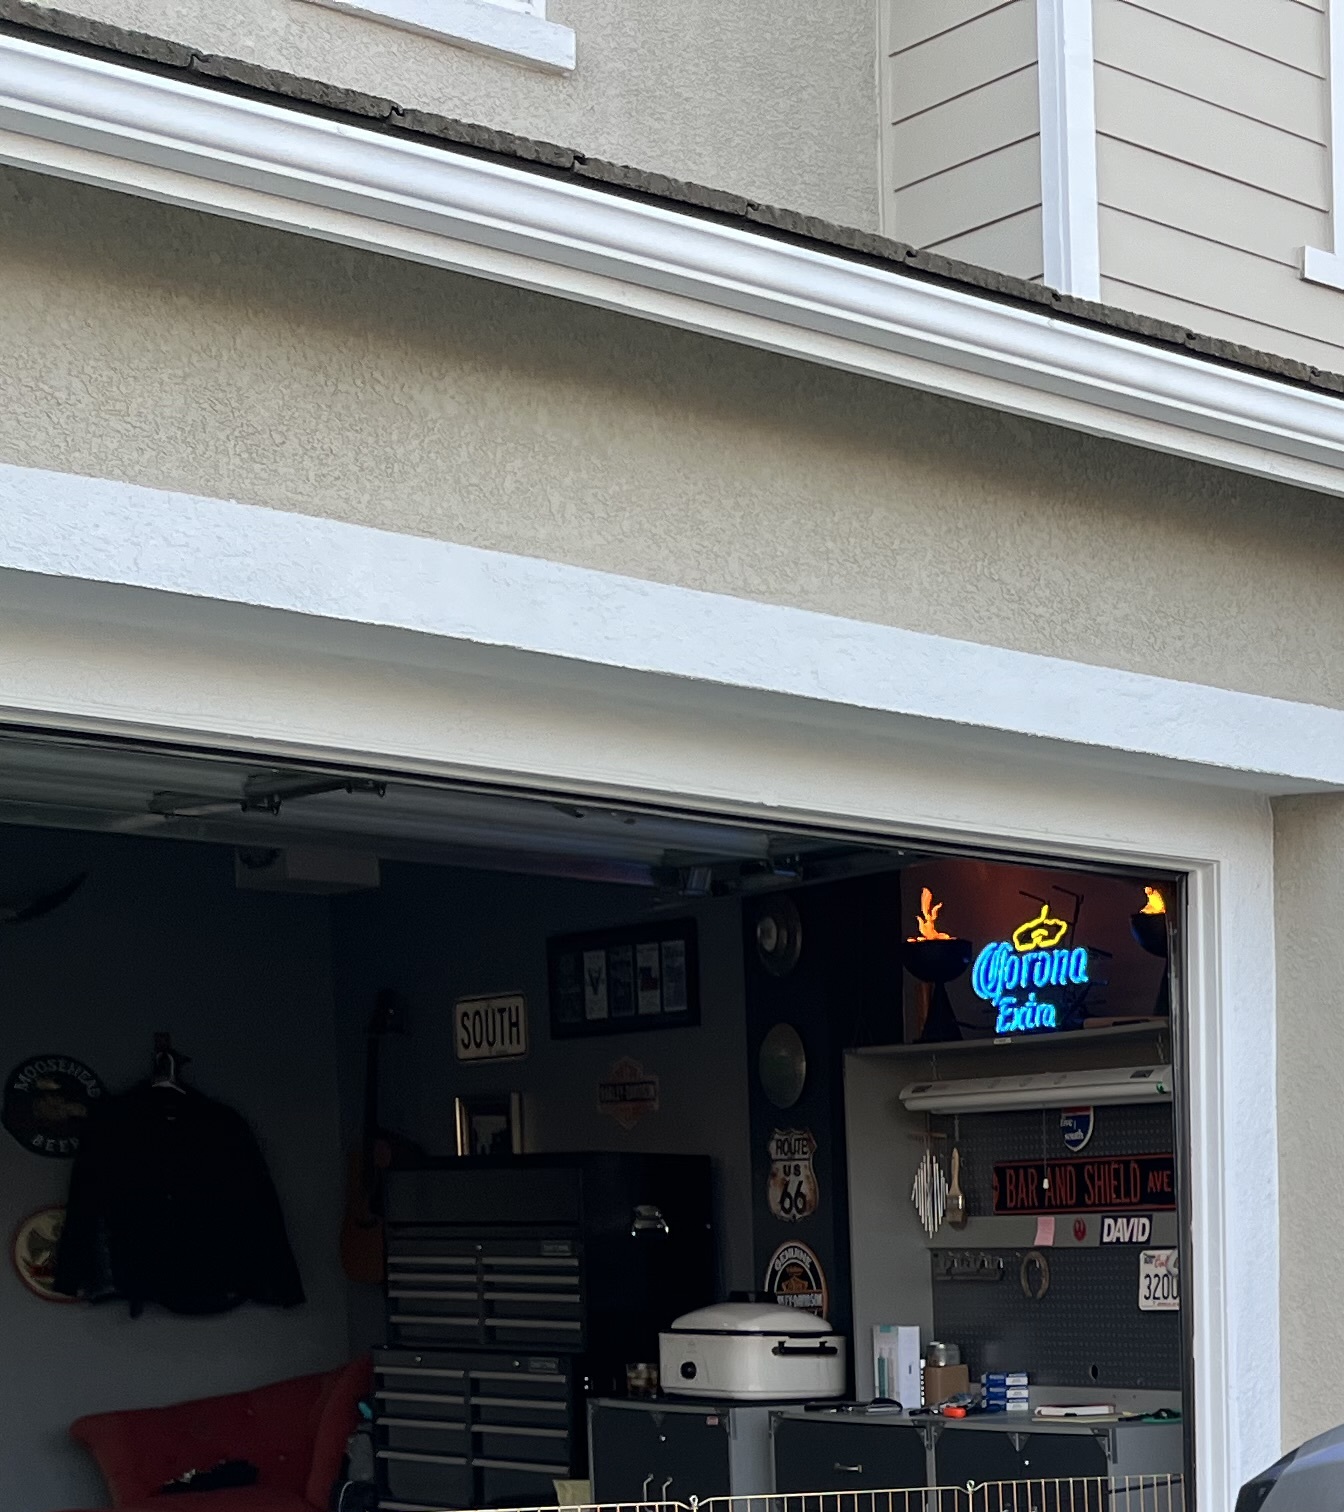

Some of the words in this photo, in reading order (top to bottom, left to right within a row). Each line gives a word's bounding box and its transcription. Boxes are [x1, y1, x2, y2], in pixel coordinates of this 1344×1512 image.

[972, 941, 1089, 1006] Corona
[461, 1005, 520, 1050] SOUTH
[995, 993, 1057, 1034] Extra
[775, 1137, 808, 1157] ROUTE
[782, 1164, 801, 1177] US
[1007, 1163, 1040, 1207] BAR
[1045, 1163, 1077, 1207] AND
[1084, 1160, 1141, 1205] SHIELD
[1147, 1169, 1173, 1194] AVE
[780, 1179, 806, 1216] 66
[1102, 1217, 1151, 1243] DAVID
